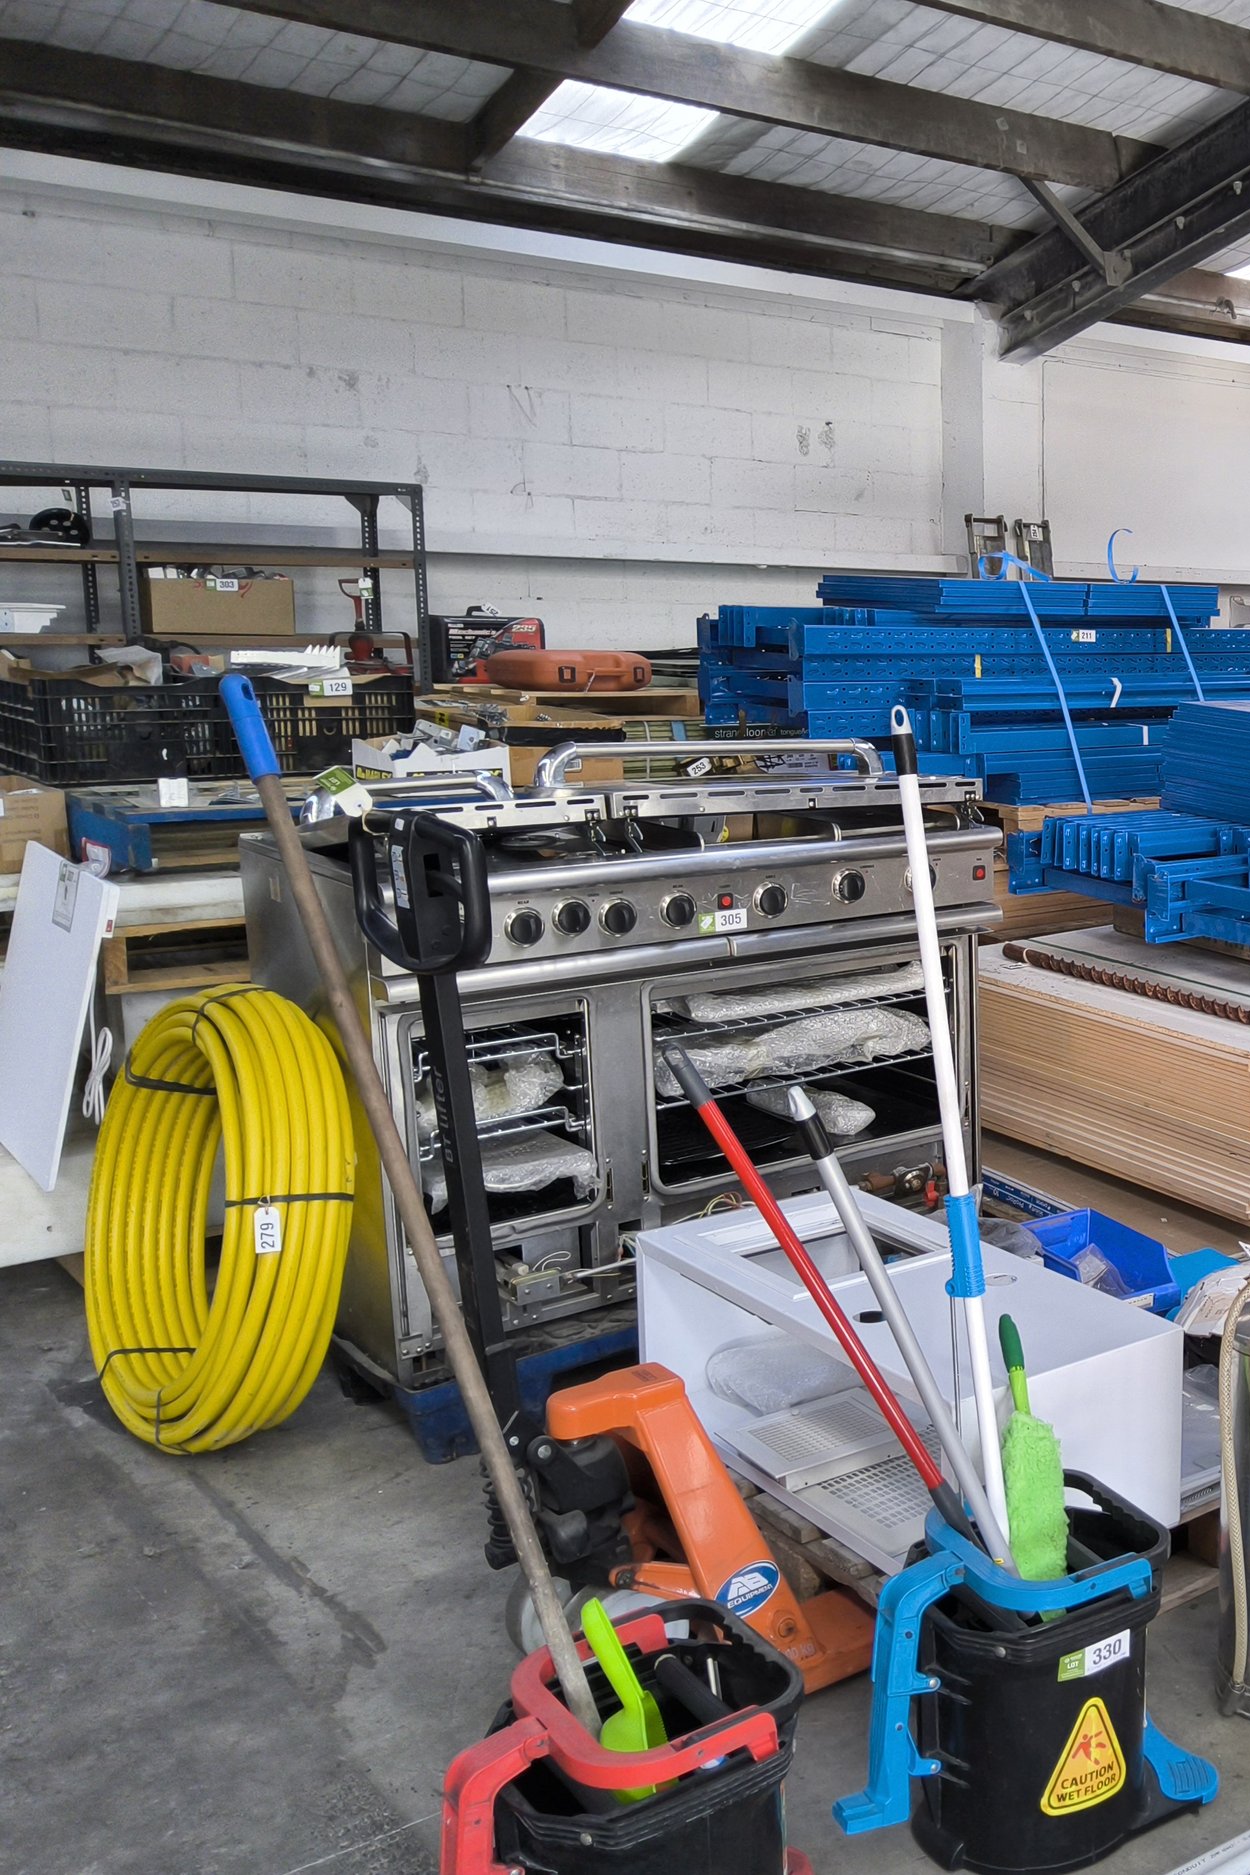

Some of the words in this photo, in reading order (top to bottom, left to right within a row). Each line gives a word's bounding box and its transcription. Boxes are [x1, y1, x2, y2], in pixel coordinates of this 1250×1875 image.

[219, 580, 235, 589] 303
[329, 683, 347, 692] 129
[691, 762, 706, 775] 253
[720, 913, 742, 926] 305
[260, 1222, 275, 1249] 279
[727, 1572, 769, 1600] AB
[1092, 1639, 1122, 1665] 330
[1067, 1660, 1079, 1669] LOT
[1061, 1761, 1114, 1790] CAUTION
[1056, 1788, 1081, 1803] WET
[1084, 1773, 1117, 1795] FLOOR
